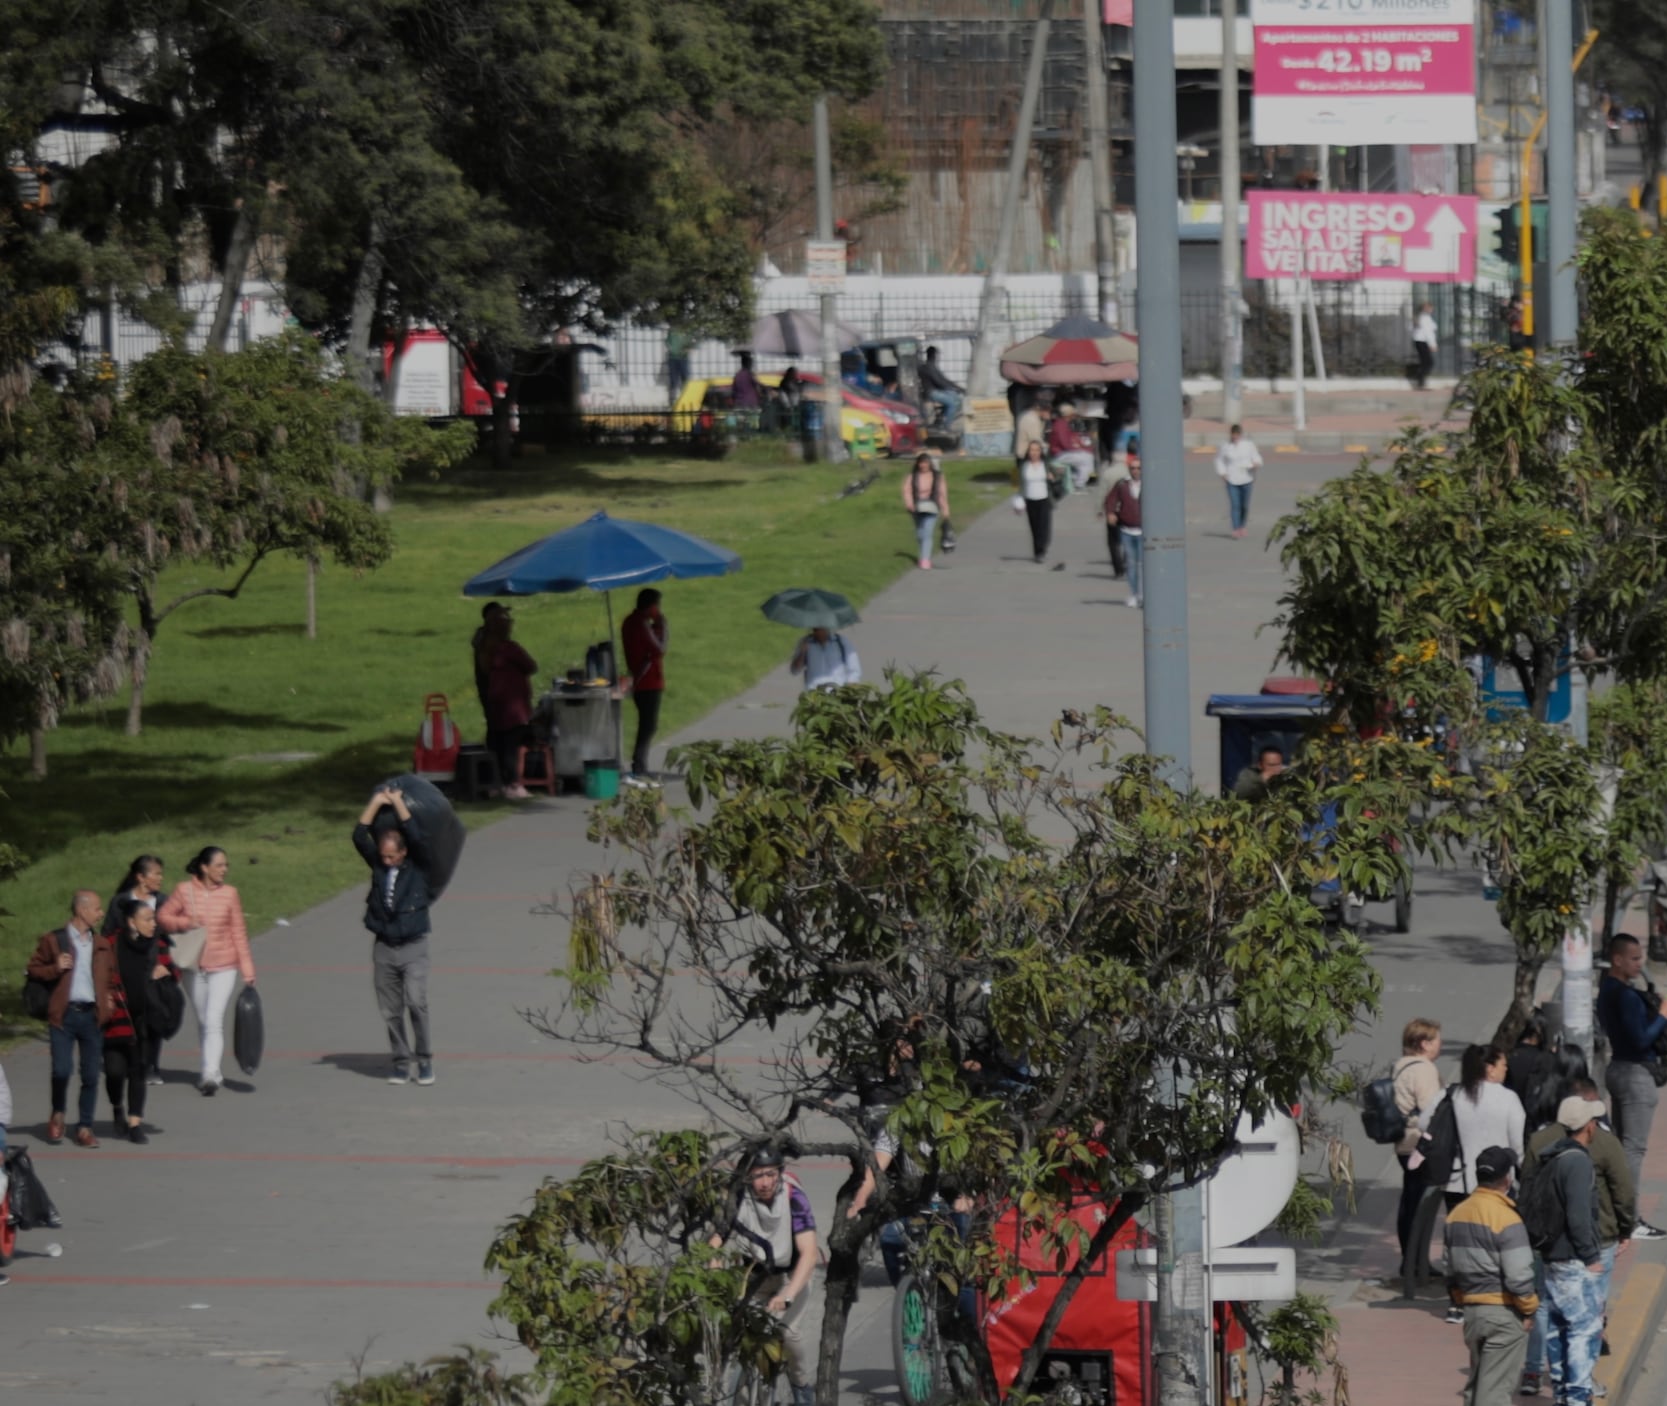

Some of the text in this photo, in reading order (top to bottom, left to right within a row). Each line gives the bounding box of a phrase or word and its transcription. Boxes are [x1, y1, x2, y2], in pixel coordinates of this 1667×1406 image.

[1317, 49, 1392, 73] 42.19
[1262, 202, 1415, 232] INGRESO
[1331, 231, 1363, 250] DE
